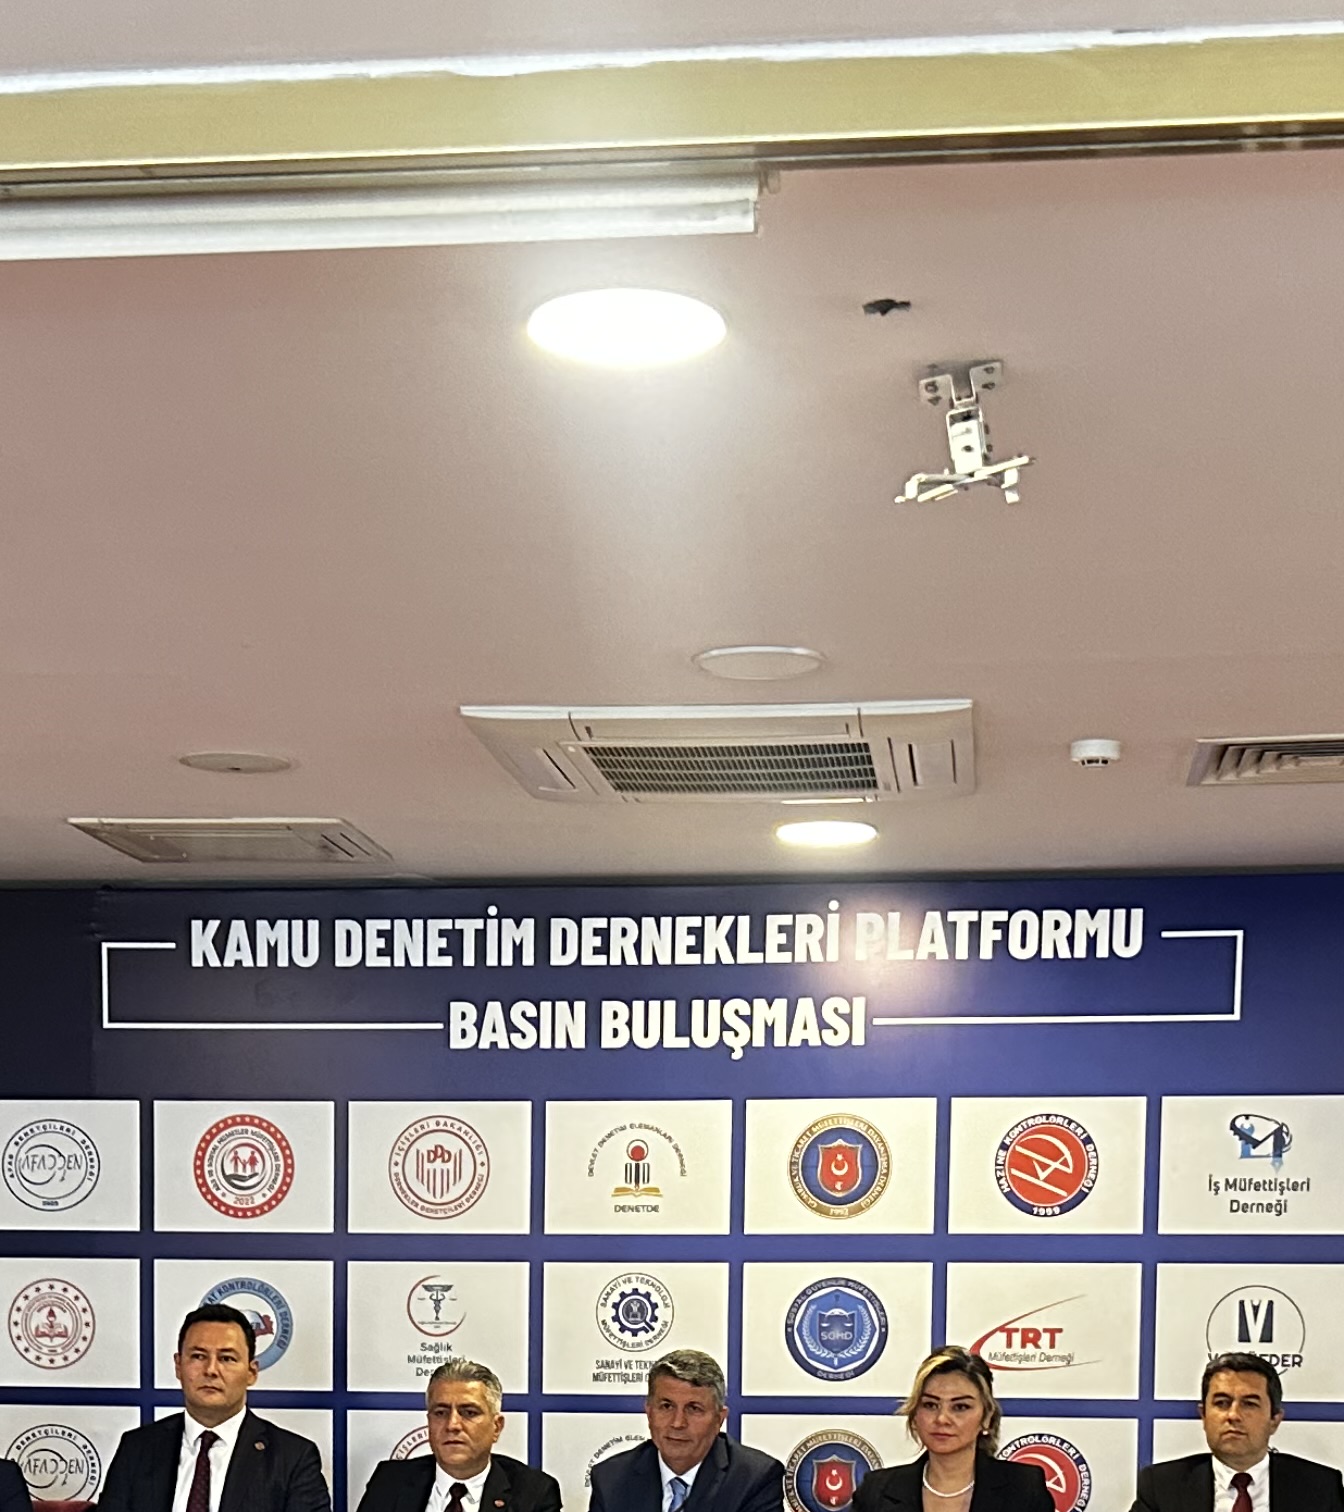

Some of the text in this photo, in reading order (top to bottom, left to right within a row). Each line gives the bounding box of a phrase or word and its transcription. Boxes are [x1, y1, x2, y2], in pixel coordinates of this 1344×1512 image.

[190, 900, 1144, 968] KAMU DENETİM DERNEKLERİ PLATFORMU
[449, 996, 866, 1060] BASIN BULUŞMASI
[1208, 1173, 1311, 1196] İş Müfettişleri
[233, 1195, 256, 1206] 2022
[1229, 1199, 1288, 1217] Derneği
[621, 1276, 634, 1286] VE
[419, 1341, 453, 1354] Sağlık
[998, 1327, 1064, 1349] TRT
[595, 1358, 623, 1371] SANAYİ
[623, 1360, 634, 1371] VE
[396, 1429, 428, 1460] ÇİŞLERİ
